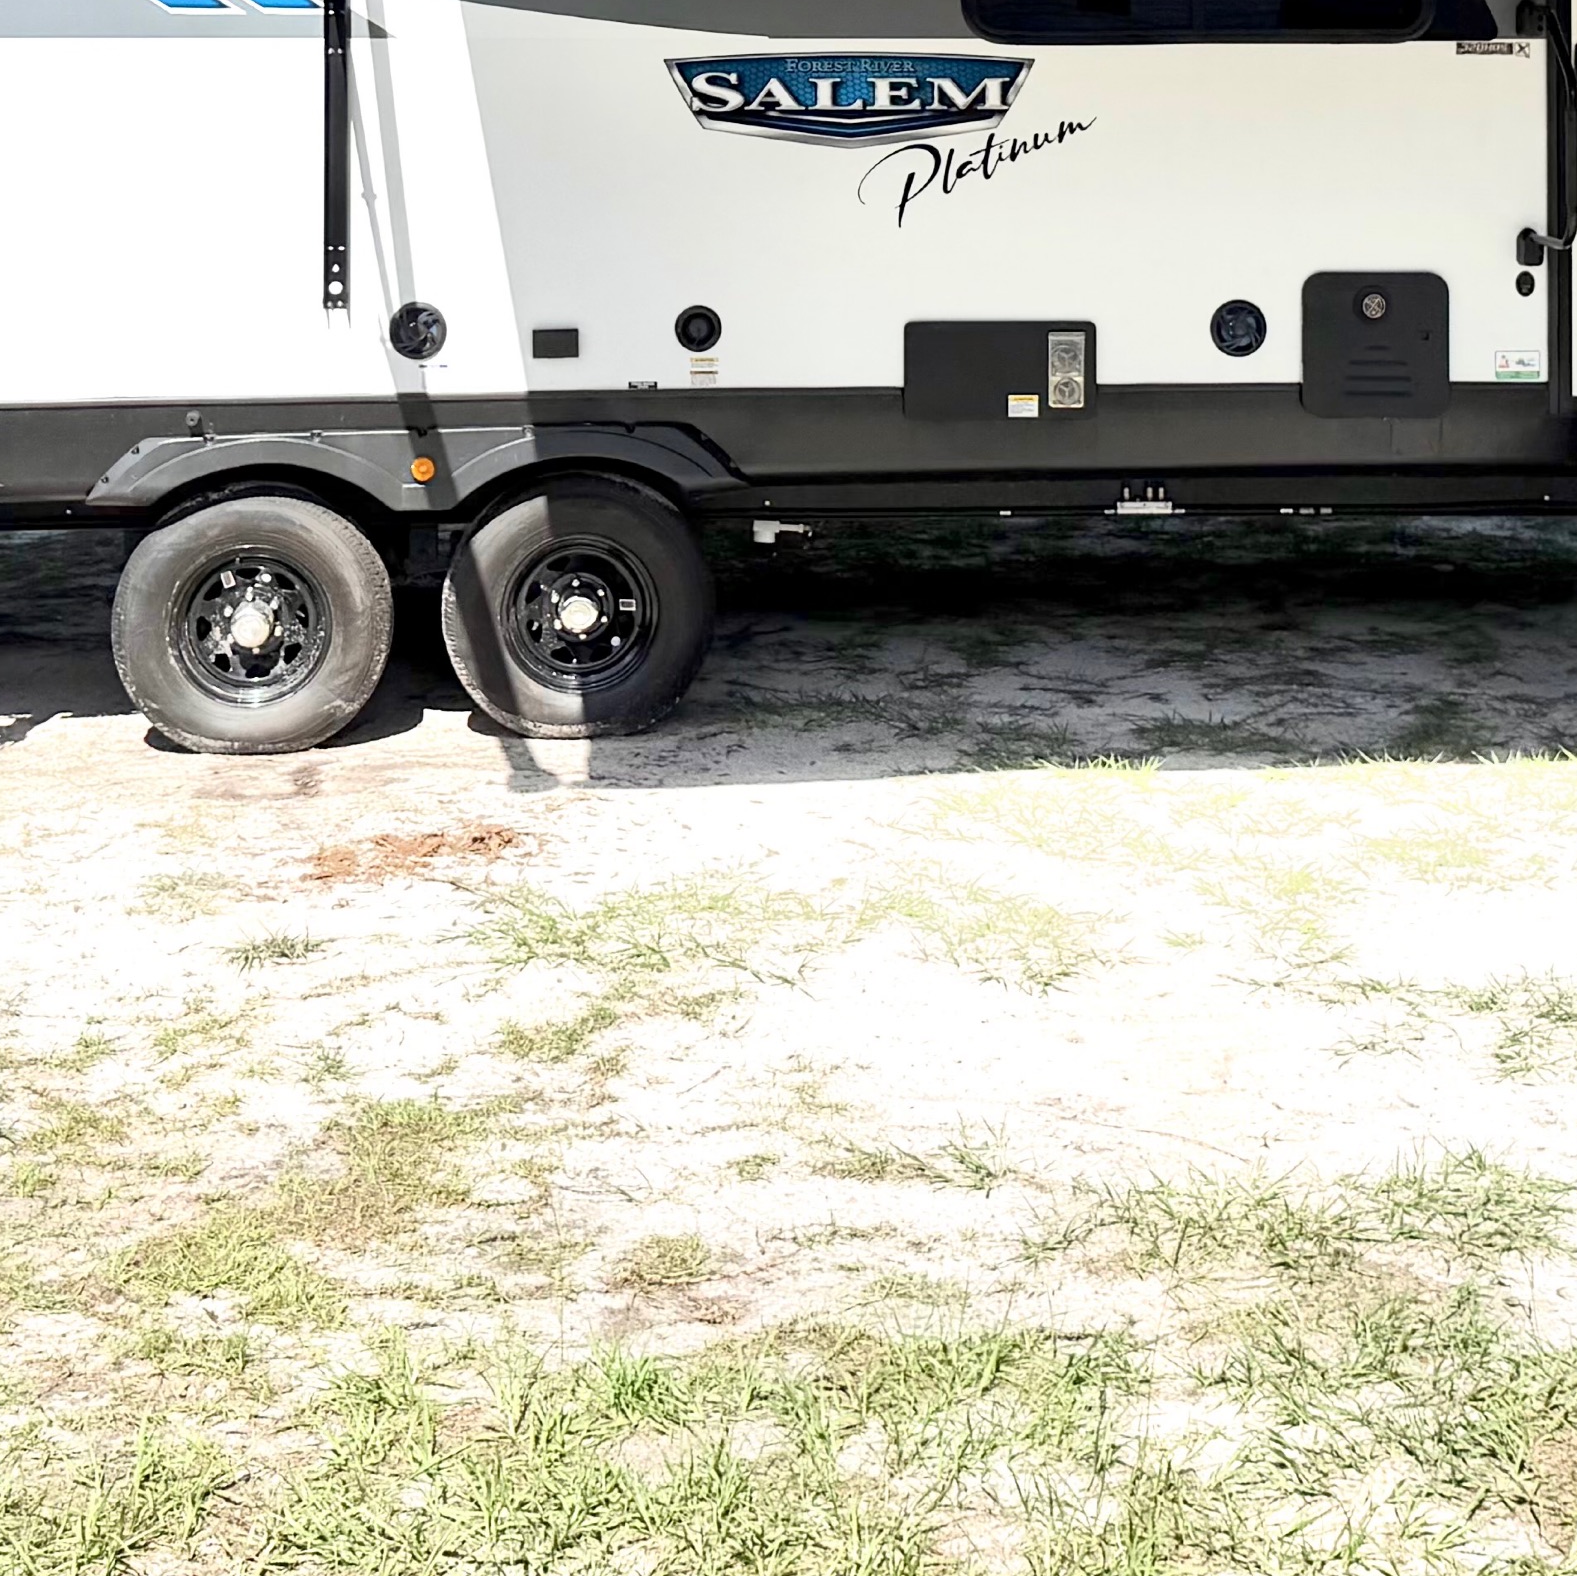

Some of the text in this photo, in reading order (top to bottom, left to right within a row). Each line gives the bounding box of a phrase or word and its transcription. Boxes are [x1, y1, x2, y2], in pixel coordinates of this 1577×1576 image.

[785, 58, 915, 72] FOREST RIVER
[690, 71, 1011, 112] SALEM
[857, 116, 1098, 229] Platinum
